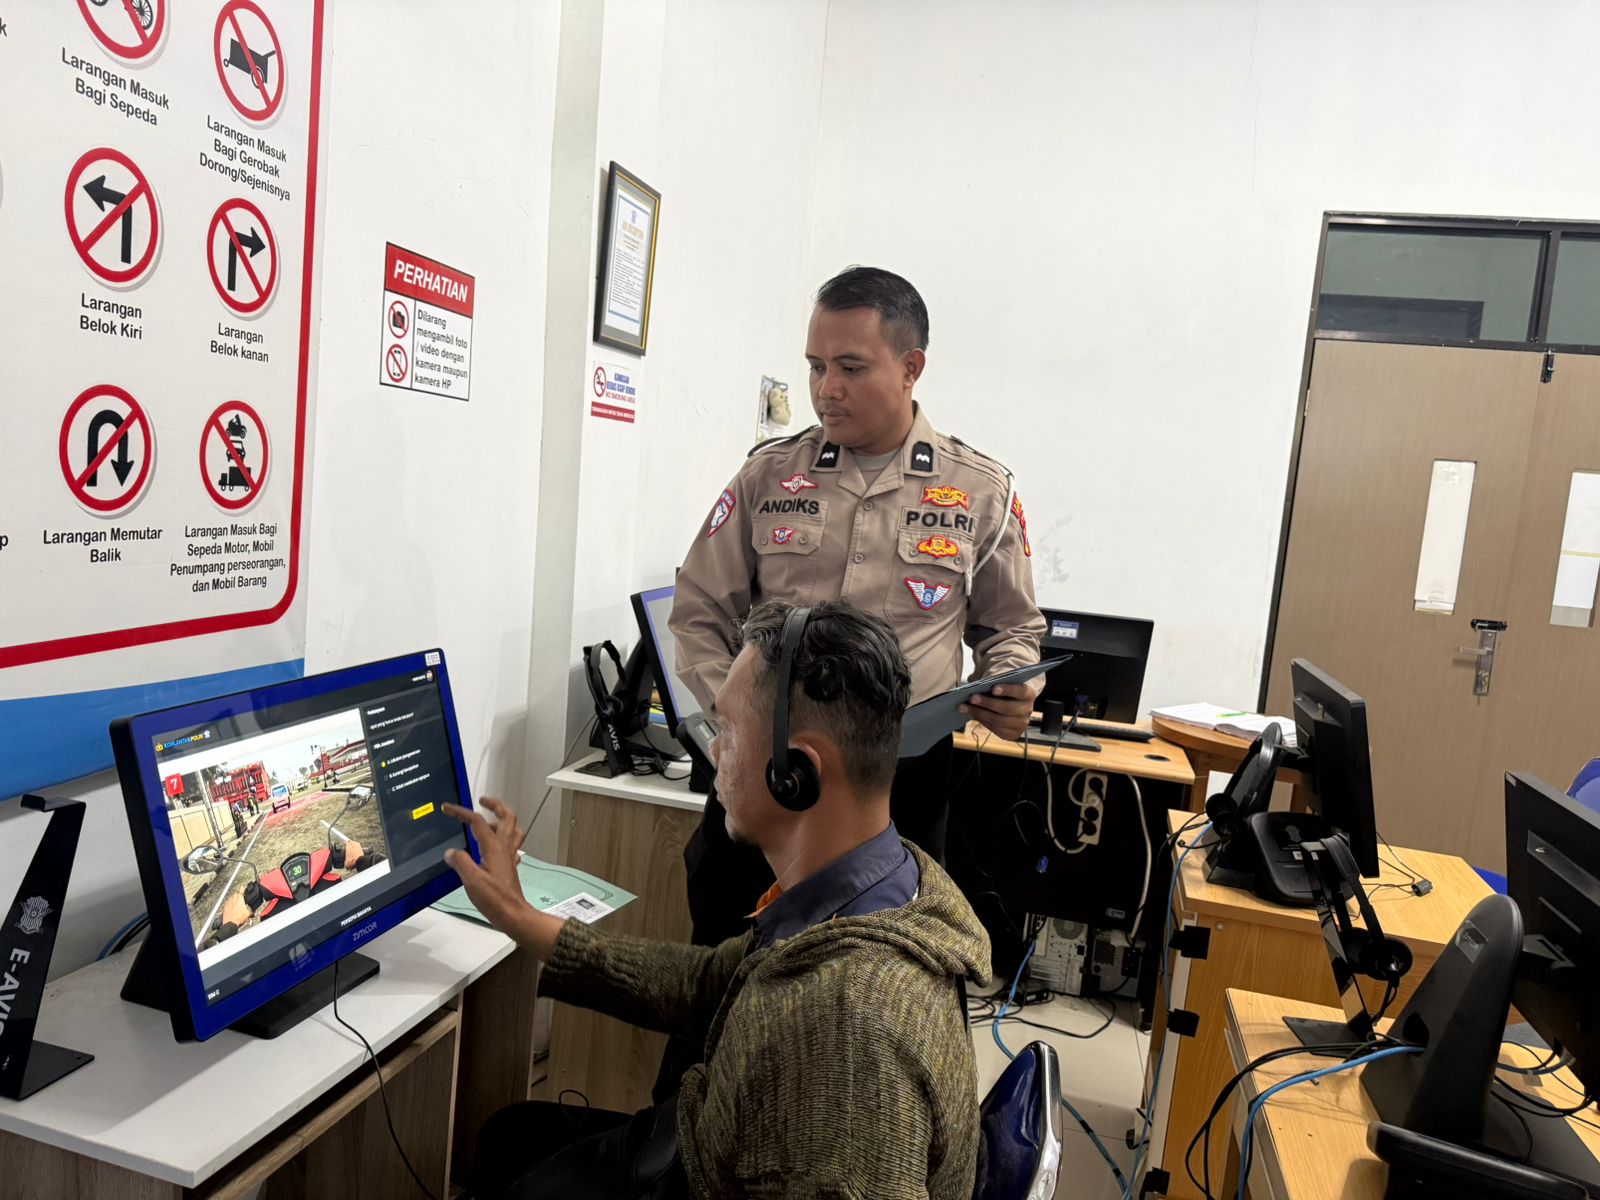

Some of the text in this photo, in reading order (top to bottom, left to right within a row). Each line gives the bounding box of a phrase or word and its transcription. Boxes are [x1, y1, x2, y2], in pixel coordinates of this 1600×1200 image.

[62, 47, 169, 110] Larangan Masuk
[75, 78, 157, 126] Bagi Sepeda
[207, 115, 287, 163] Larangan Masuk
[214, 138, 280, 178] Bagi Gerobak
[199, 152, 291, 202] Dorong/Sejenisnya
[393, 259, 468, 303] PERHATIAN
[81, 292, 142, 320] Larangan
[80, 315, 143, 340] Belok Kiri
[418, 309, 447, 330] Dilarang
[218, 323, 263, 344] Larangan
[417, 327, 468, 349] mengambil foto
[210, 341, 269, 363] Belok kanan
[420, 344, 440, 356] video
[441, 348, 465, 364] dengan
[415, 357, 468, 380] kamera maupun
[414, 372, 452, 390] kamera HP
[759, 497, 819, 514] ANDIKS
[185, 522, 277, 540] Larangan Masuk Bagi
[906, 510, 974, 533] POLRI
[43, 527, 163, 546] Larangan Memutar
[90, 548, 121, 563] Balik
[187, 540, 274, 558] Sepeda Motor, Mobil
[170, 557, 286, 577] Penumpang perseorangan,
[192, 575, 267, 592] dan Mobil Barang
[170, 778, 178, 790] 7
[0, 947, 31, 1036] E-AVI
